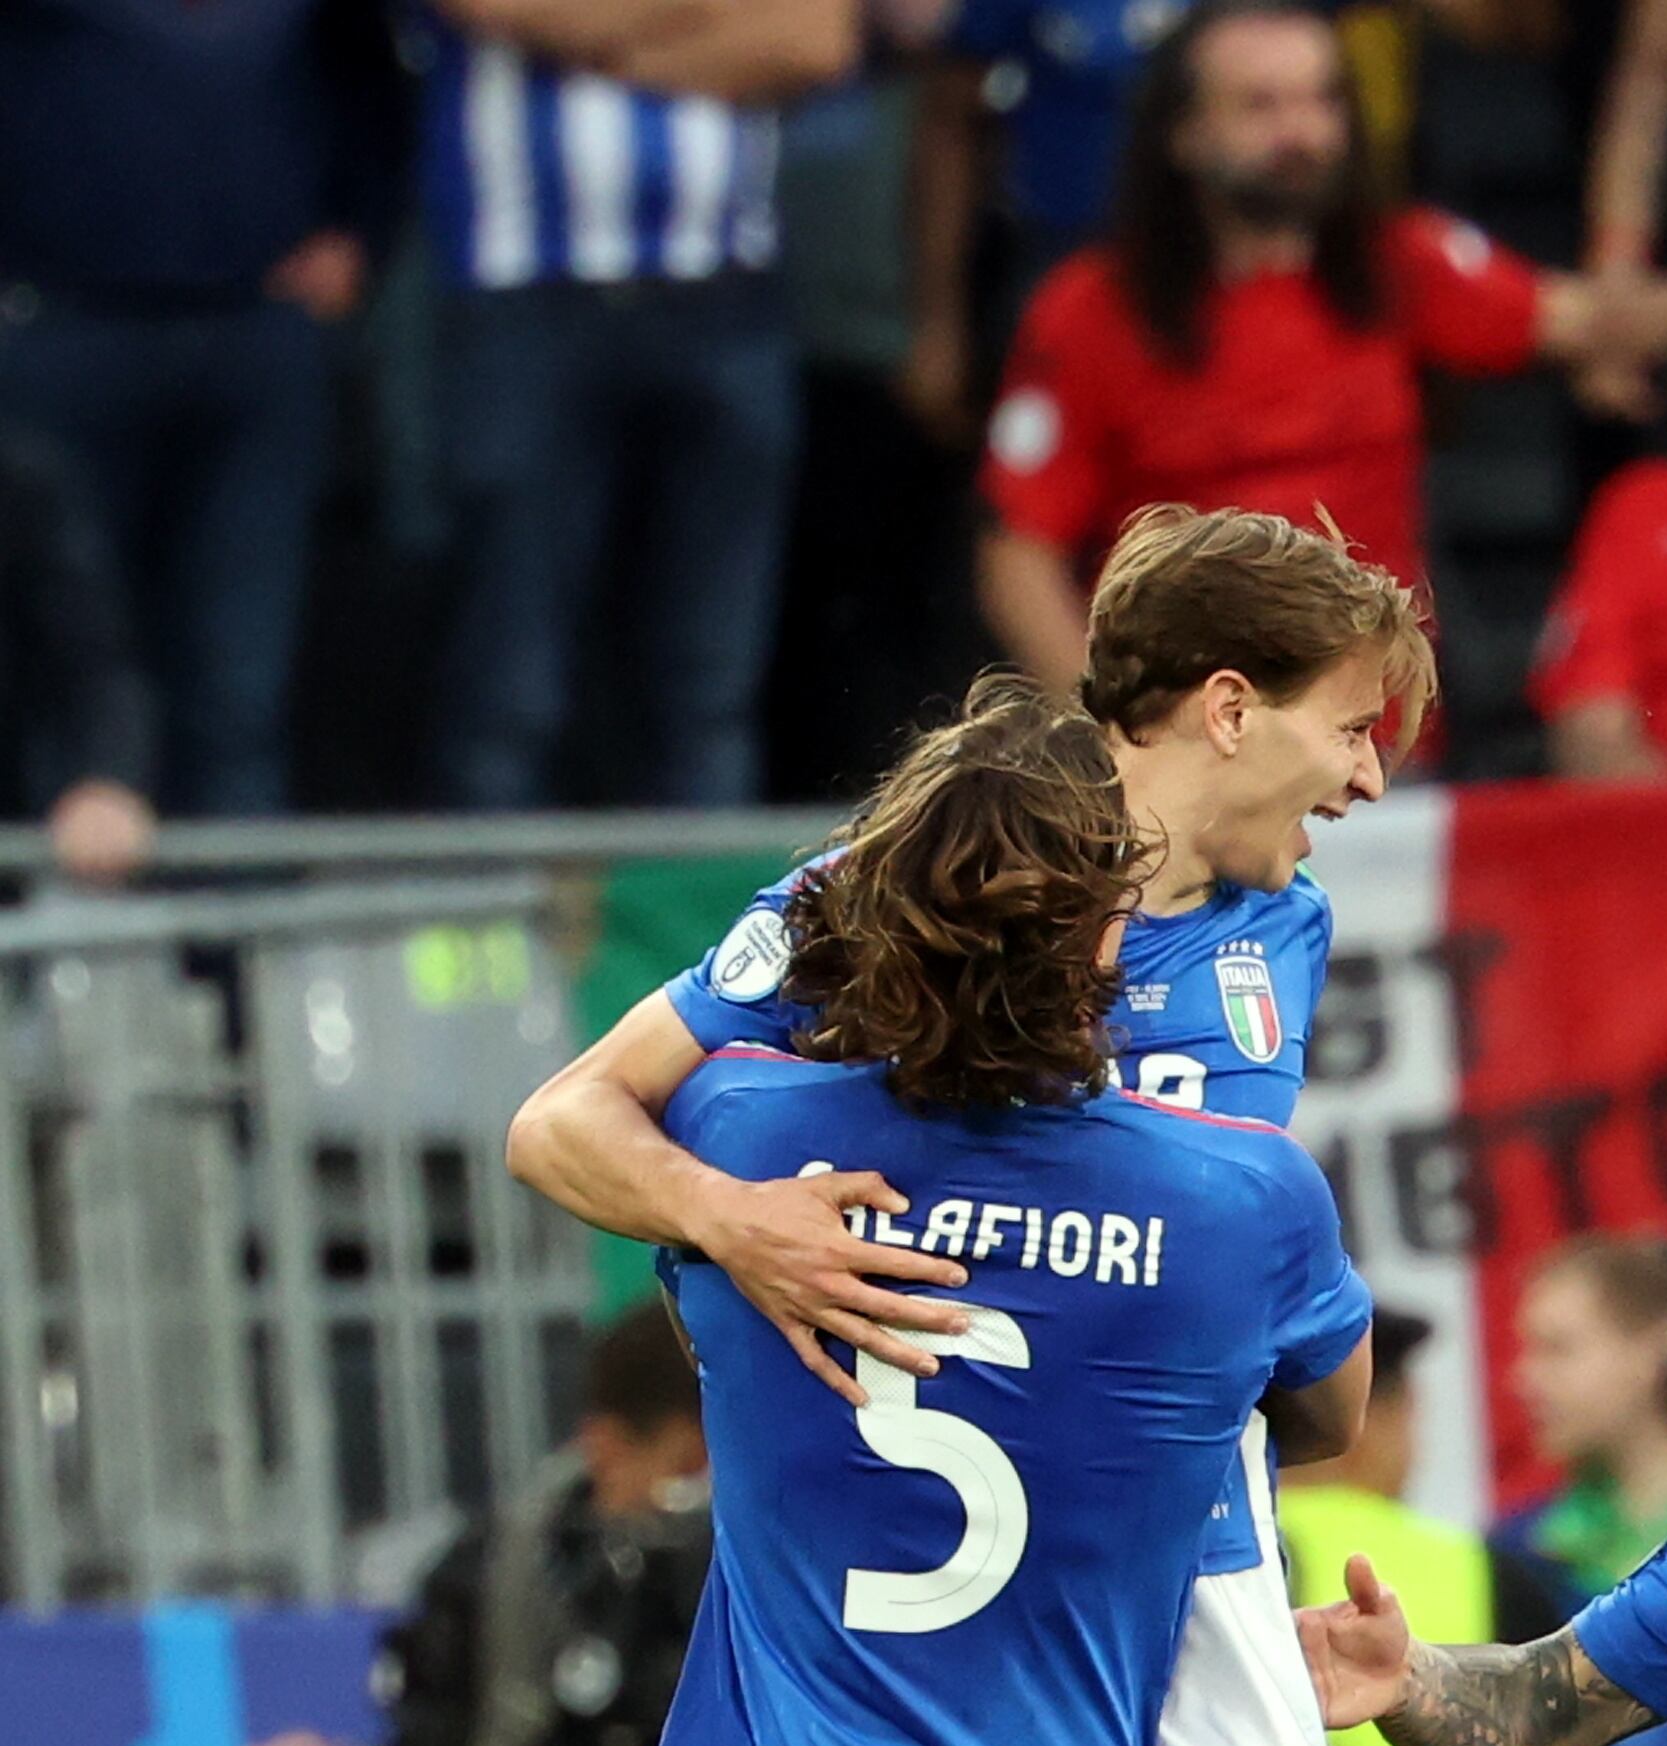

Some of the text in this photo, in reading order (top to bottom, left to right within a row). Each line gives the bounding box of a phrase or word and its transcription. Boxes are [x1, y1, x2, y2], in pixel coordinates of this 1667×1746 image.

[1221, 964, 1268, 987] ITALIA
[797, 1160, 1164, 1287] LAFIORI
[843, 1295, 1030, 1634] 5
